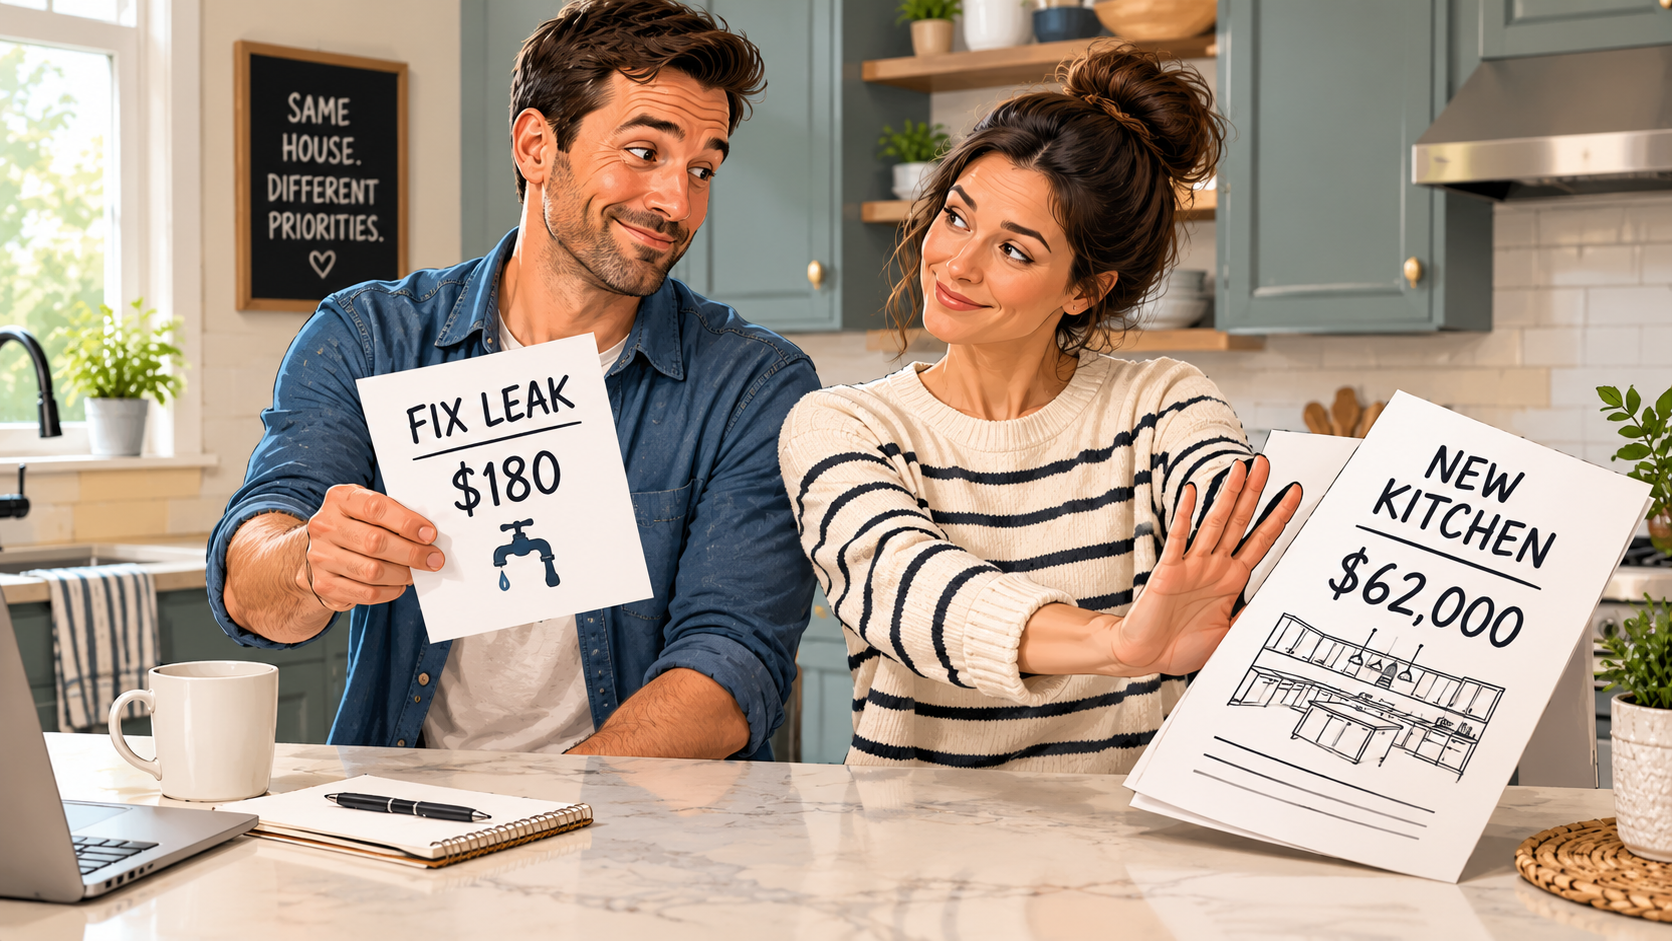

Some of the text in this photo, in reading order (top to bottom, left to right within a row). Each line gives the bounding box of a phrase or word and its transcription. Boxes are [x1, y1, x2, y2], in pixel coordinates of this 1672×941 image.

[287, 92, 350, 127] SAME
[282, 134, 362, 166] HOUSE.
[267, 173, 379, 206] DIFFERENT
[268, 211, 384, 243] PRIORITIES.
[406, 374, 577, 445] FIX LEAK
[452, 450, 561, 518] $180
[1424, 444, 1526, 504] NEW
[1372, 477, 1557, 569] KITCHEN
[1328, 546, 1525, 649] $62,000
